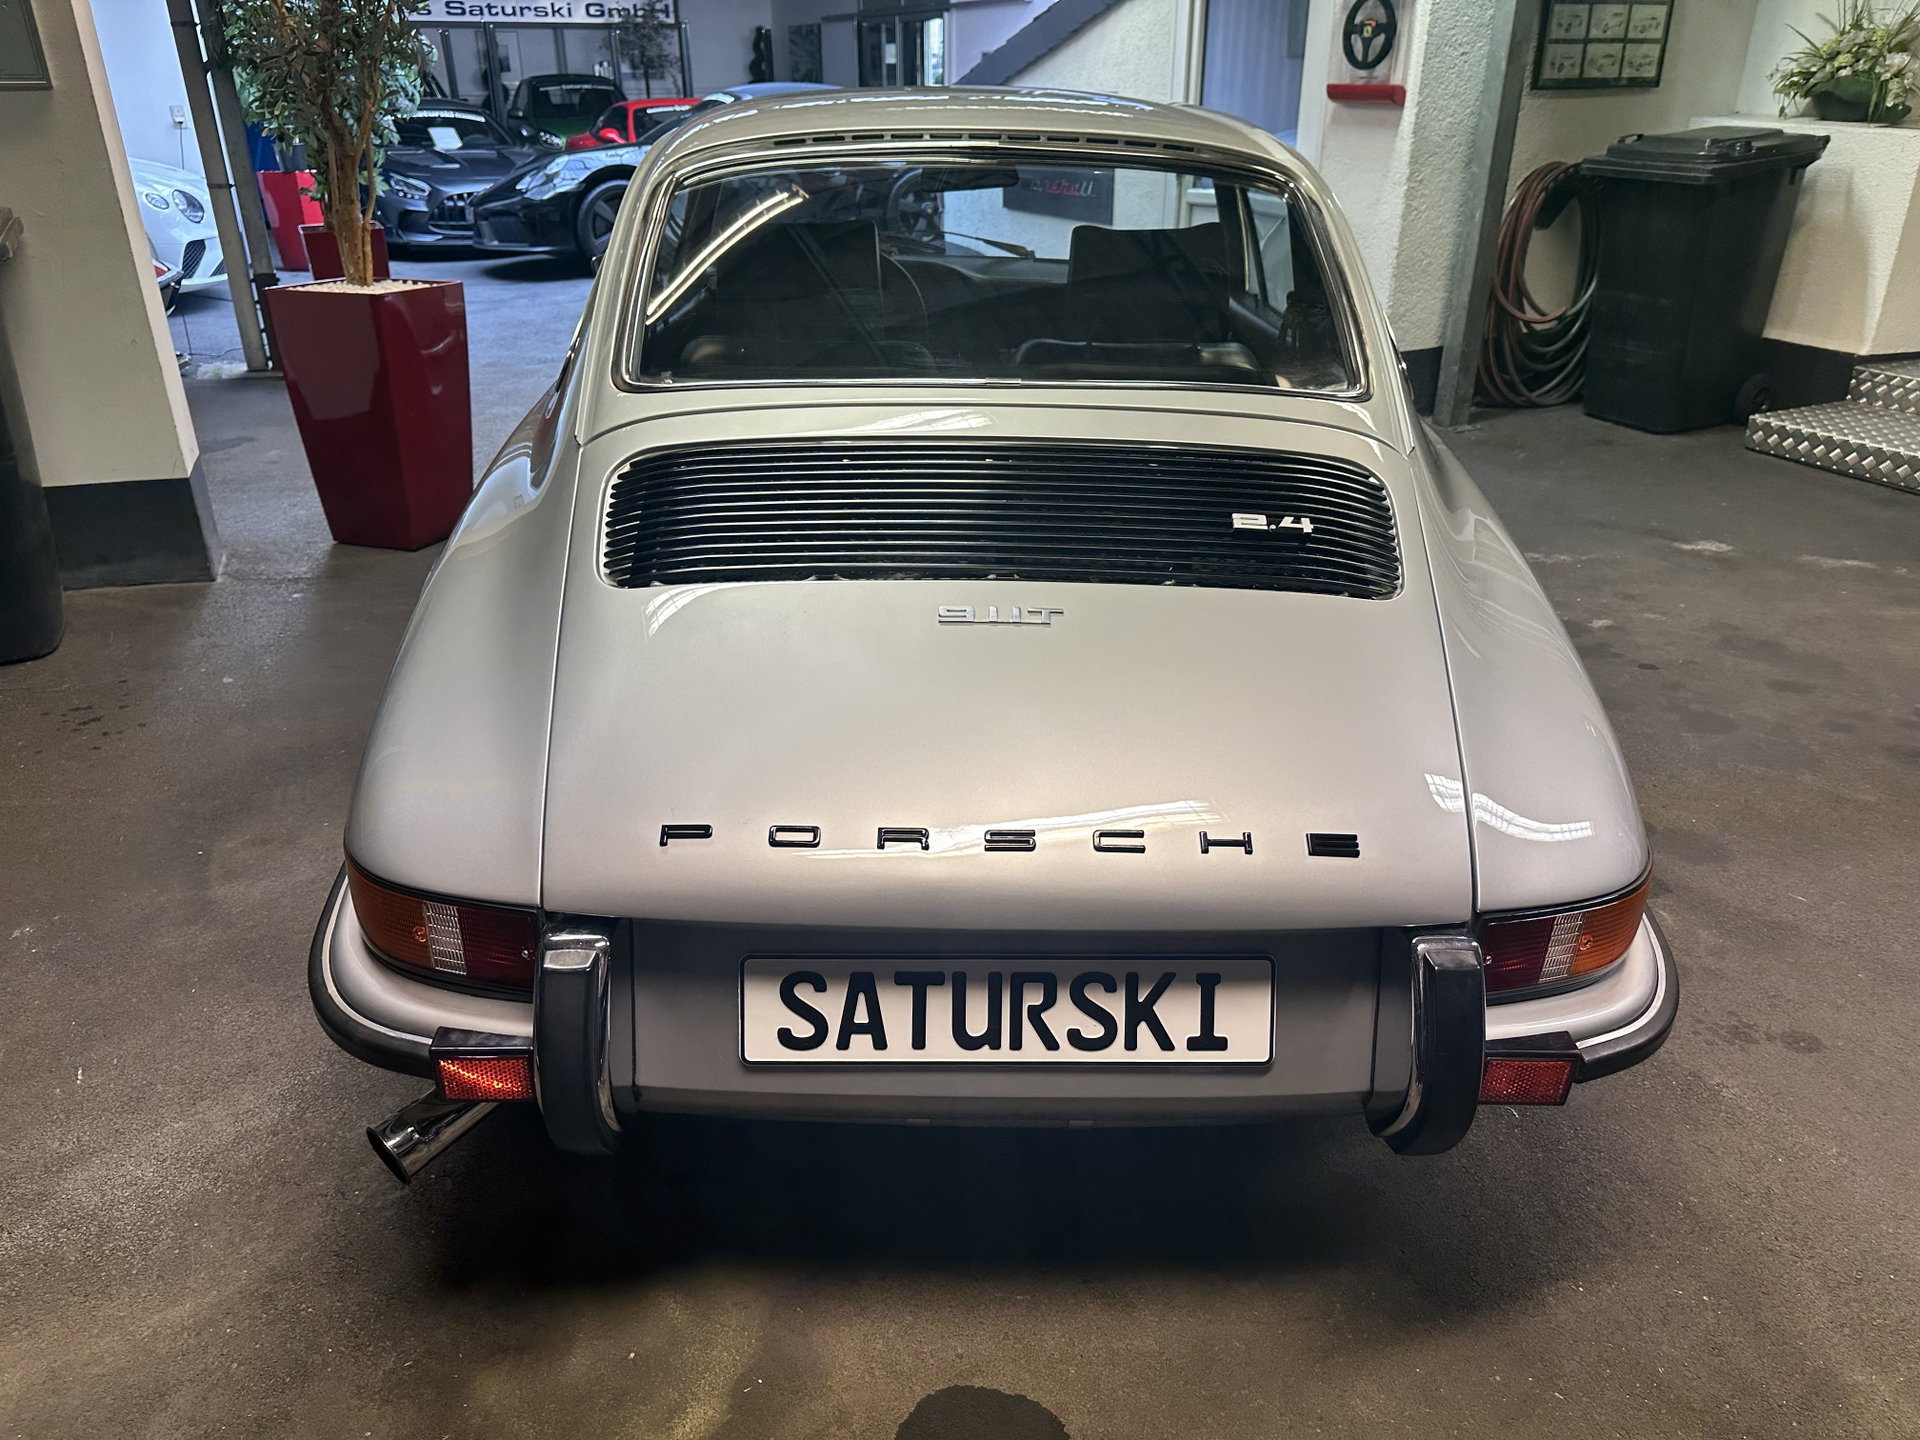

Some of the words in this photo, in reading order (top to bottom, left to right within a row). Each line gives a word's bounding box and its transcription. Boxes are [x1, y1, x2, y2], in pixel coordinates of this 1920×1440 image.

[444, 0, 573, 18] Saturski
[584, 2, 670, 19] GmbH
[1231, 512, 1315, 533] 2.4
[659, 824, 1360, 858] PORSCHE
[776, 971, 1229, 1052] SATURSKI
